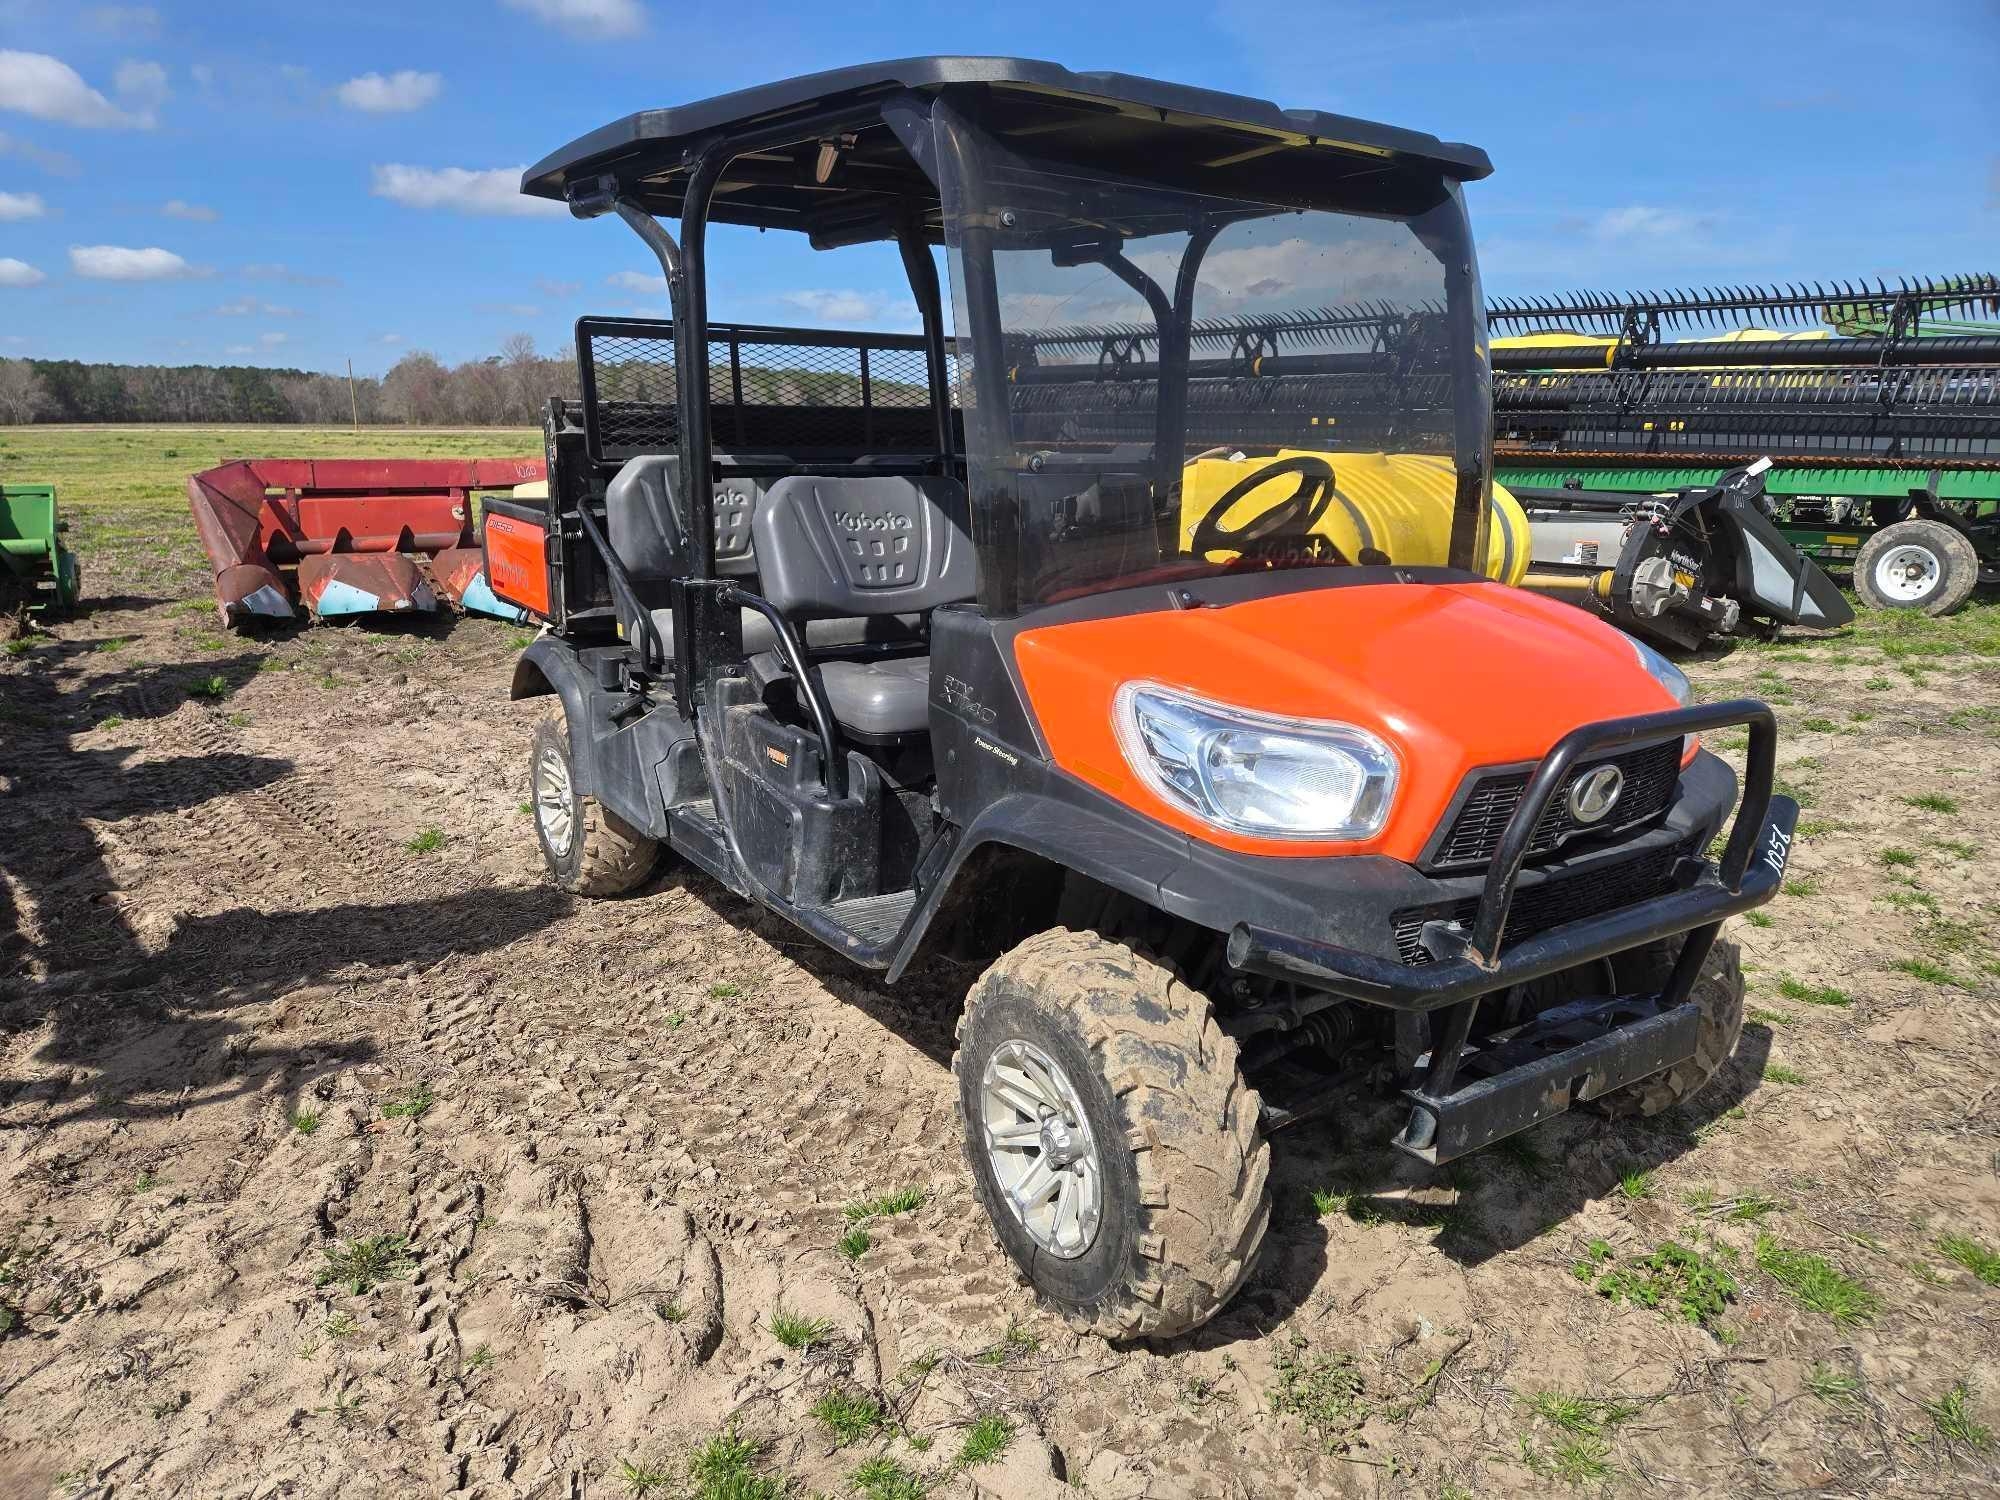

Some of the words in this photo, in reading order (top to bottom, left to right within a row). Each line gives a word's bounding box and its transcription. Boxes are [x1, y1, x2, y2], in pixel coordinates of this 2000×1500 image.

[833, 511, 913, 532] Kubota
[974, 736, 994, 752] Power
[992, 746, 1018, 767] Steering
[1763, 823, 1791, 878] 1056
